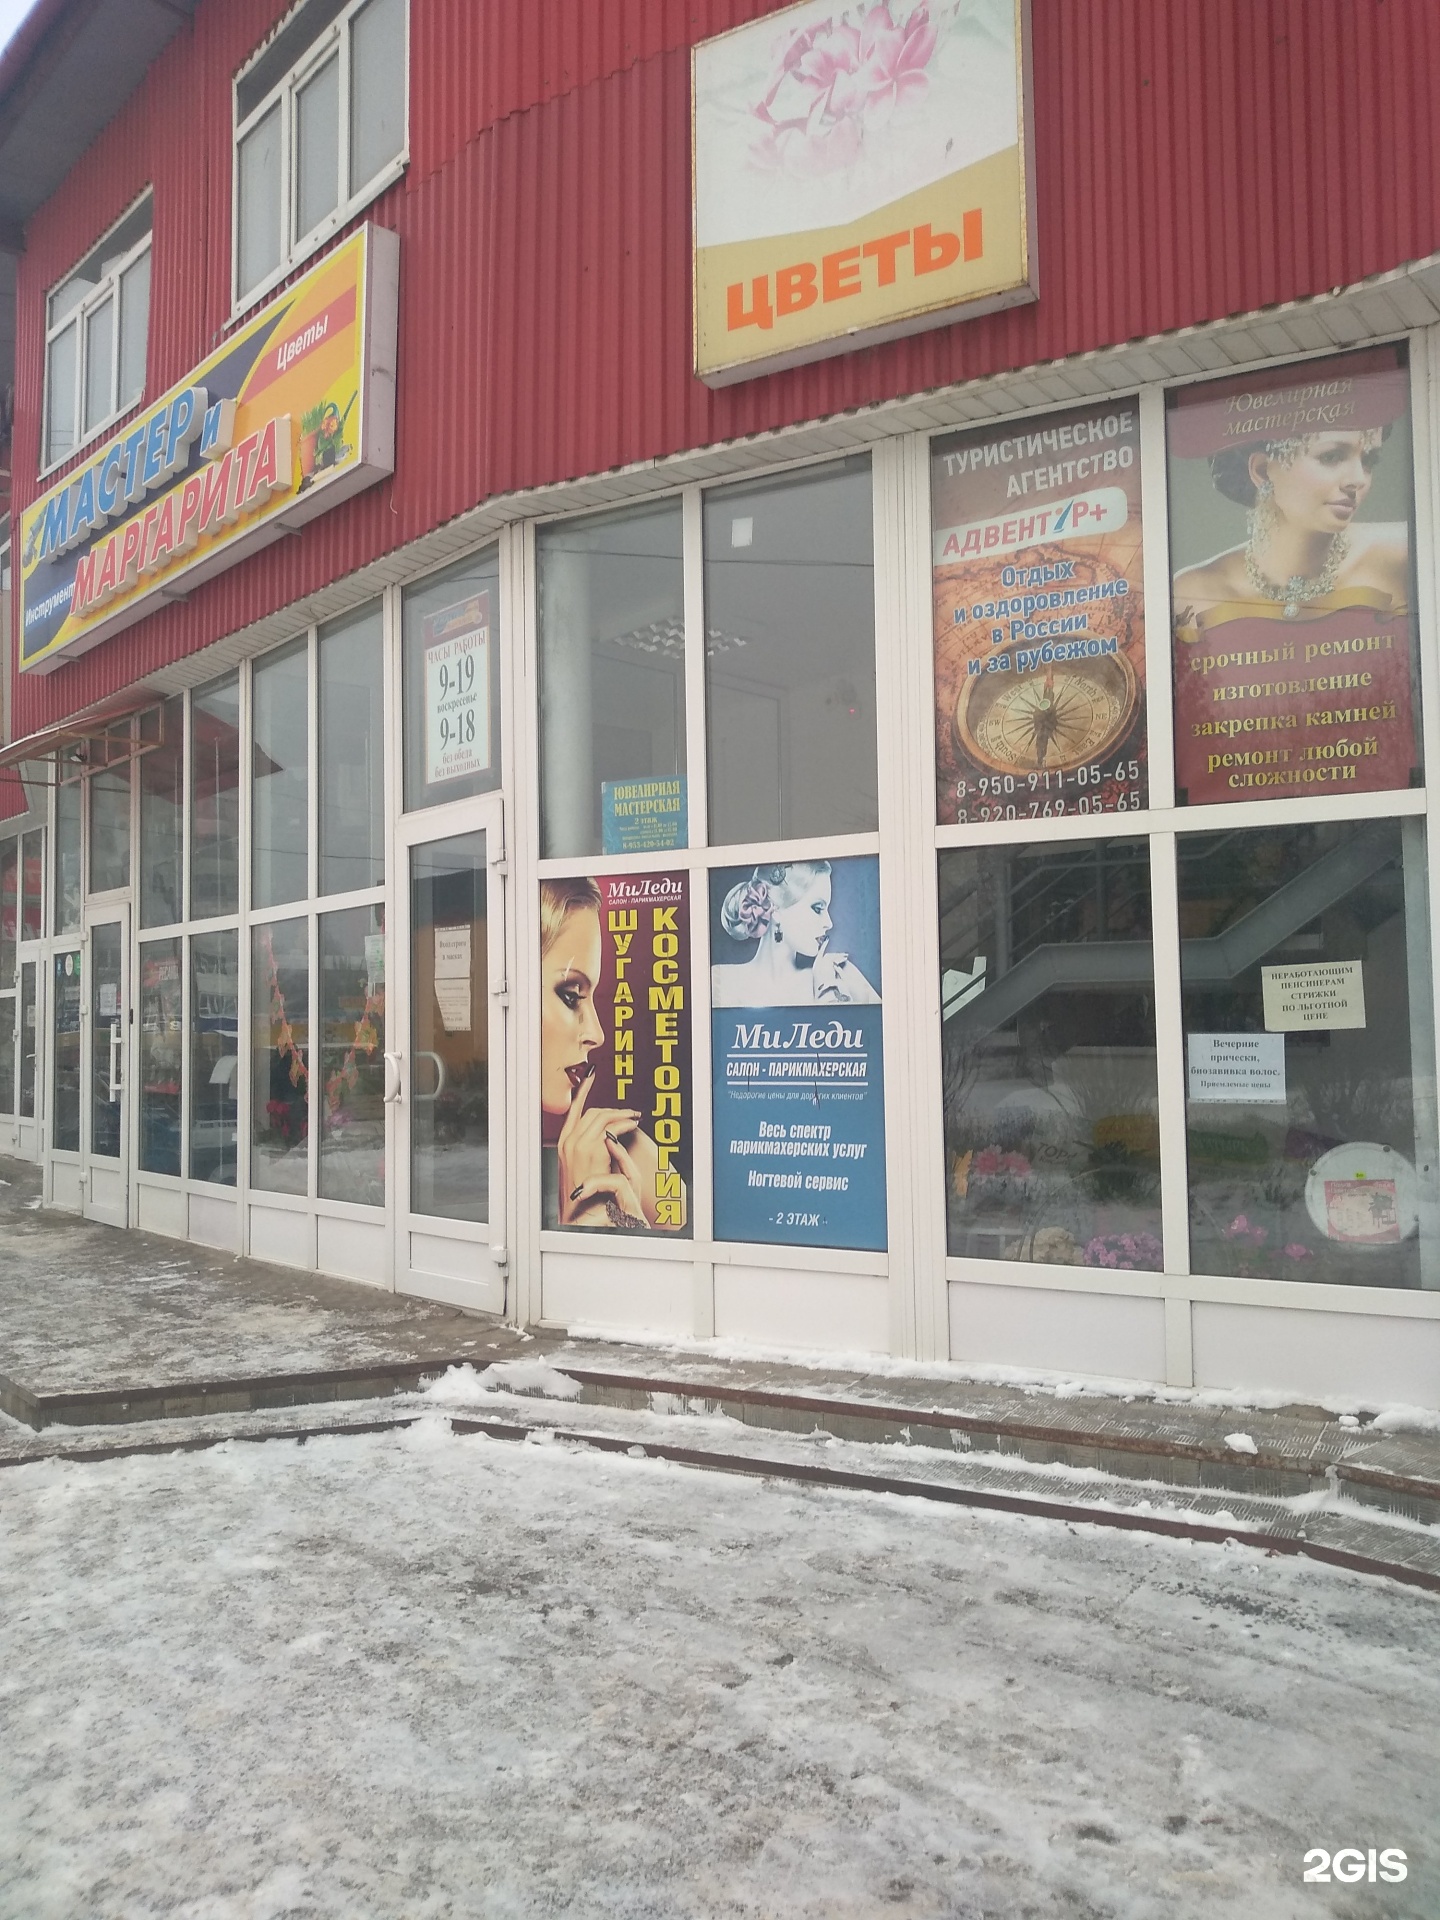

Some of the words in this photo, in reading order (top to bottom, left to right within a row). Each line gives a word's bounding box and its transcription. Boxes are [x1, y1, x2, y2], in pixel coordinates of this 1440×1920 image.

[727, 208, 983, 331] ЦВЕТЫ
[276, 315, 328, 371] Цветы
[1222, 378, 1352, 415] Ювелирная
[1222, 402, 1355, 437] мастерская
[943, 411, 1133, 476] ТУРИСТИЧЕСКОЕ
[39, 388, 195, 559] МАСТЕР
[1006, 446, 1133, 497] АГЕНТСТВО
[69, 419, 279, 617] МАРГАРИТА
[1002, 561, 1075, 588] Отдых
[954, 608, 966, 625] и
[972, 578, 1129, 620] оздоровление
[992, 628, 1003, 644] в
[1010, 613, 1088, 641] России
[428, 645, 450, 664] ЧАСЫ
[454, 630, 486, 655] РАБОТЫ
[968, 659, 981, 675] и
[986, 653, 1011, 673] за
[1016, 636, 1118, 674] рубежом
[1190, 642, 1295, 675] срочный
[1304, 634, 1395, 663] ремонт
[439, 654, 475, 701] 9-19
[1213, 671, 1373, 701] изготовление
[440, 709, 475, 751] 9-18
[1191, 714, 1298, 737] закрепка
[1305, 700, 1397, 727] камней
[1208, 748, 1293, 773] ремонт
[1299, 737, 1379, 762] любой
[614, 781, 680, 800] ЮВЕЛИРНАЯ
[956, 760, 1139, 798] 8-950-911-05-65
[1228, 765, 1357, 788] сложности
[614, 798, 680, 816] МАСТЕРСКАЯ
[957, 791, 1141, 824] 8-920-769-05-65
[607, 878, 682, 898] МиЛеди
[1271, 966, 1354, 980] НЕРАБОТАЮЩИМ
[1281, 977, 1345, 990] ПЕНСИНЕРАМ
[607, 909, 638, 1100] ШУГАРИНГ
[1282, 1003, 1296, 1013] ПО
[1297, 999, 1348, 1012] ЛЬГОТНОЙ
[1290, 990, 1337, 1000] СТРИЖКИ
[1303, 1011, 1329, 1022] ЦЕНЕ
[731, 1021, 864, 1049] МиЛеди
[1213, 1039, 1260, 1050] Вечерние
[648, 906, 684, 1225] КОСМЕТОЛОГИЯ
[726, 1062, 759, 1077] САЛОН
[768, 1062, 866, 1077] ПАРИКМАХЕРСКАЯ
[1190, 1065, 1247, 1076] биозавивка
[1249, 1067, 1281, 1077] волос.
[1210, 1053, 1261, 1064] прически,
[1200, 1080, 1249, 1090] Приемлемые
[1251, 1082, 1271, 1090] цены
[759, 1121, 786, 1138] Весь
[790, 1124, 831, 1141] спектр
[730, 1140, 829, 1158] парикмахерских
[833, 1142, 867, 1160] услуг
[748, 1170, 802, 1189] Ногтевой
[805, 1175, 849, 1191] сервис
[776, 1212, 784, 1225] 2
[786, 1213, 820, 1226] ЭТАЖ
